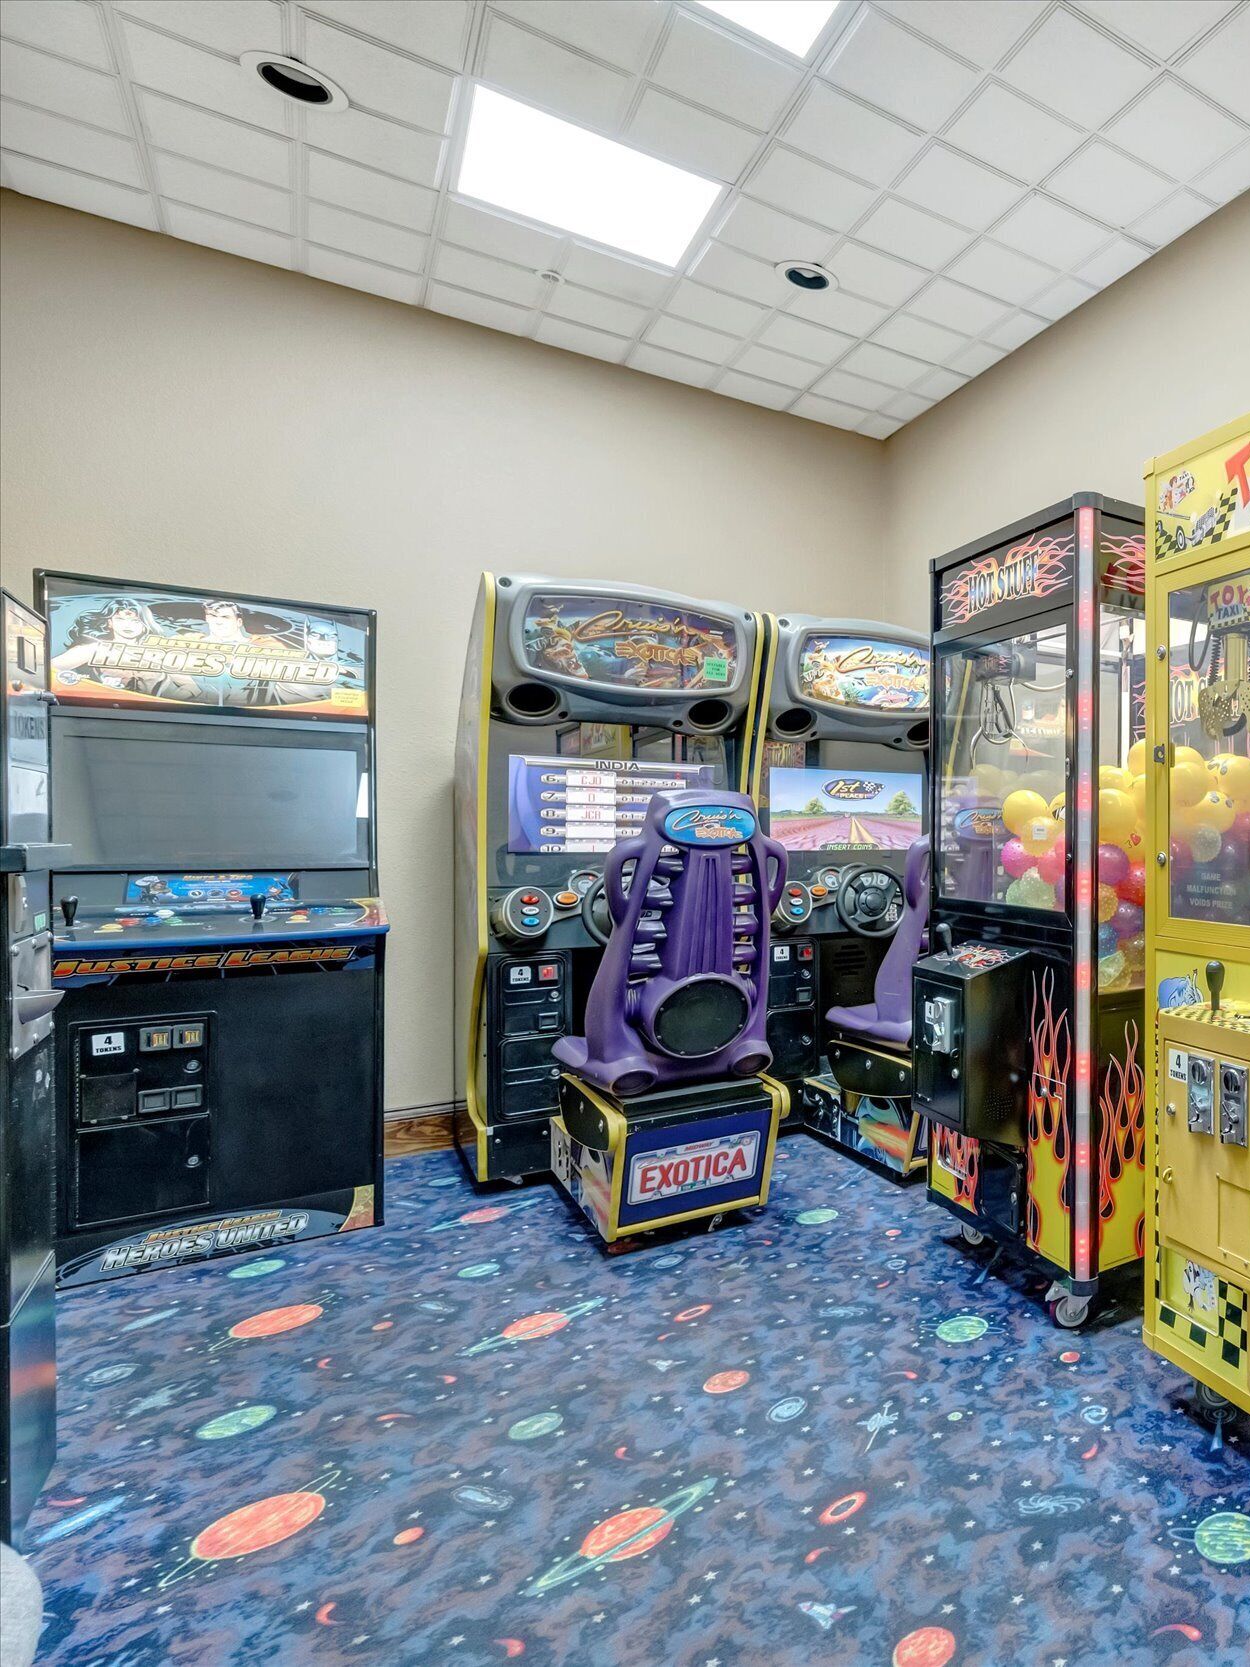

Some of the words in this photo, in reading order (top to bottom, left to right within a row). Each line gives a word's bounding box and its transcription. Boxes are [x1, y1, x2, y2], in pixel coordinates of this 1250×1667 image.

[967, 571, 995, 614] HOT
[998, 552, 1041, 603] STUFF
[1210, 585, 1248, 612] TOY
[1216, 605, 1240, 619] TAXI
[573, 610, 697, 642] Cruis'n
[143, 636, 236, 654] JUSTICE
[90, 643, 226, 676] HEROES
[229, 655, 338, 684] UNITED
[835, 646, 926, 673] Cruis'n
[595, 761, 640, 771] INDIA
[830, 781, 860, 795] 1st
[671, 810, 742, 830] Cruis'n
[695, 827, 743, 839] EXOTICA
[1201, 872, 1221, 881] GAME
[1187, 885, 1236, 896] MALFUNCTION
[1190, 898, 1211, 907] VOIDS
[1212, 900, 1232, 909] PRIZE
[54, 954, 223, 977] JUSTICE
[221, 947, 357, 968] LEAGUE
[104, 1036, 113, 1045] 4
[1175, 1054, 1182, 1069] 4
[1170, 1069, 1186, 1081] TOKENS
[639, 1147, 747, 1193] EXOTICA
[101, 1232, 214, 1271] HEROES
[215, 1214, 309, 1248] UNITED
